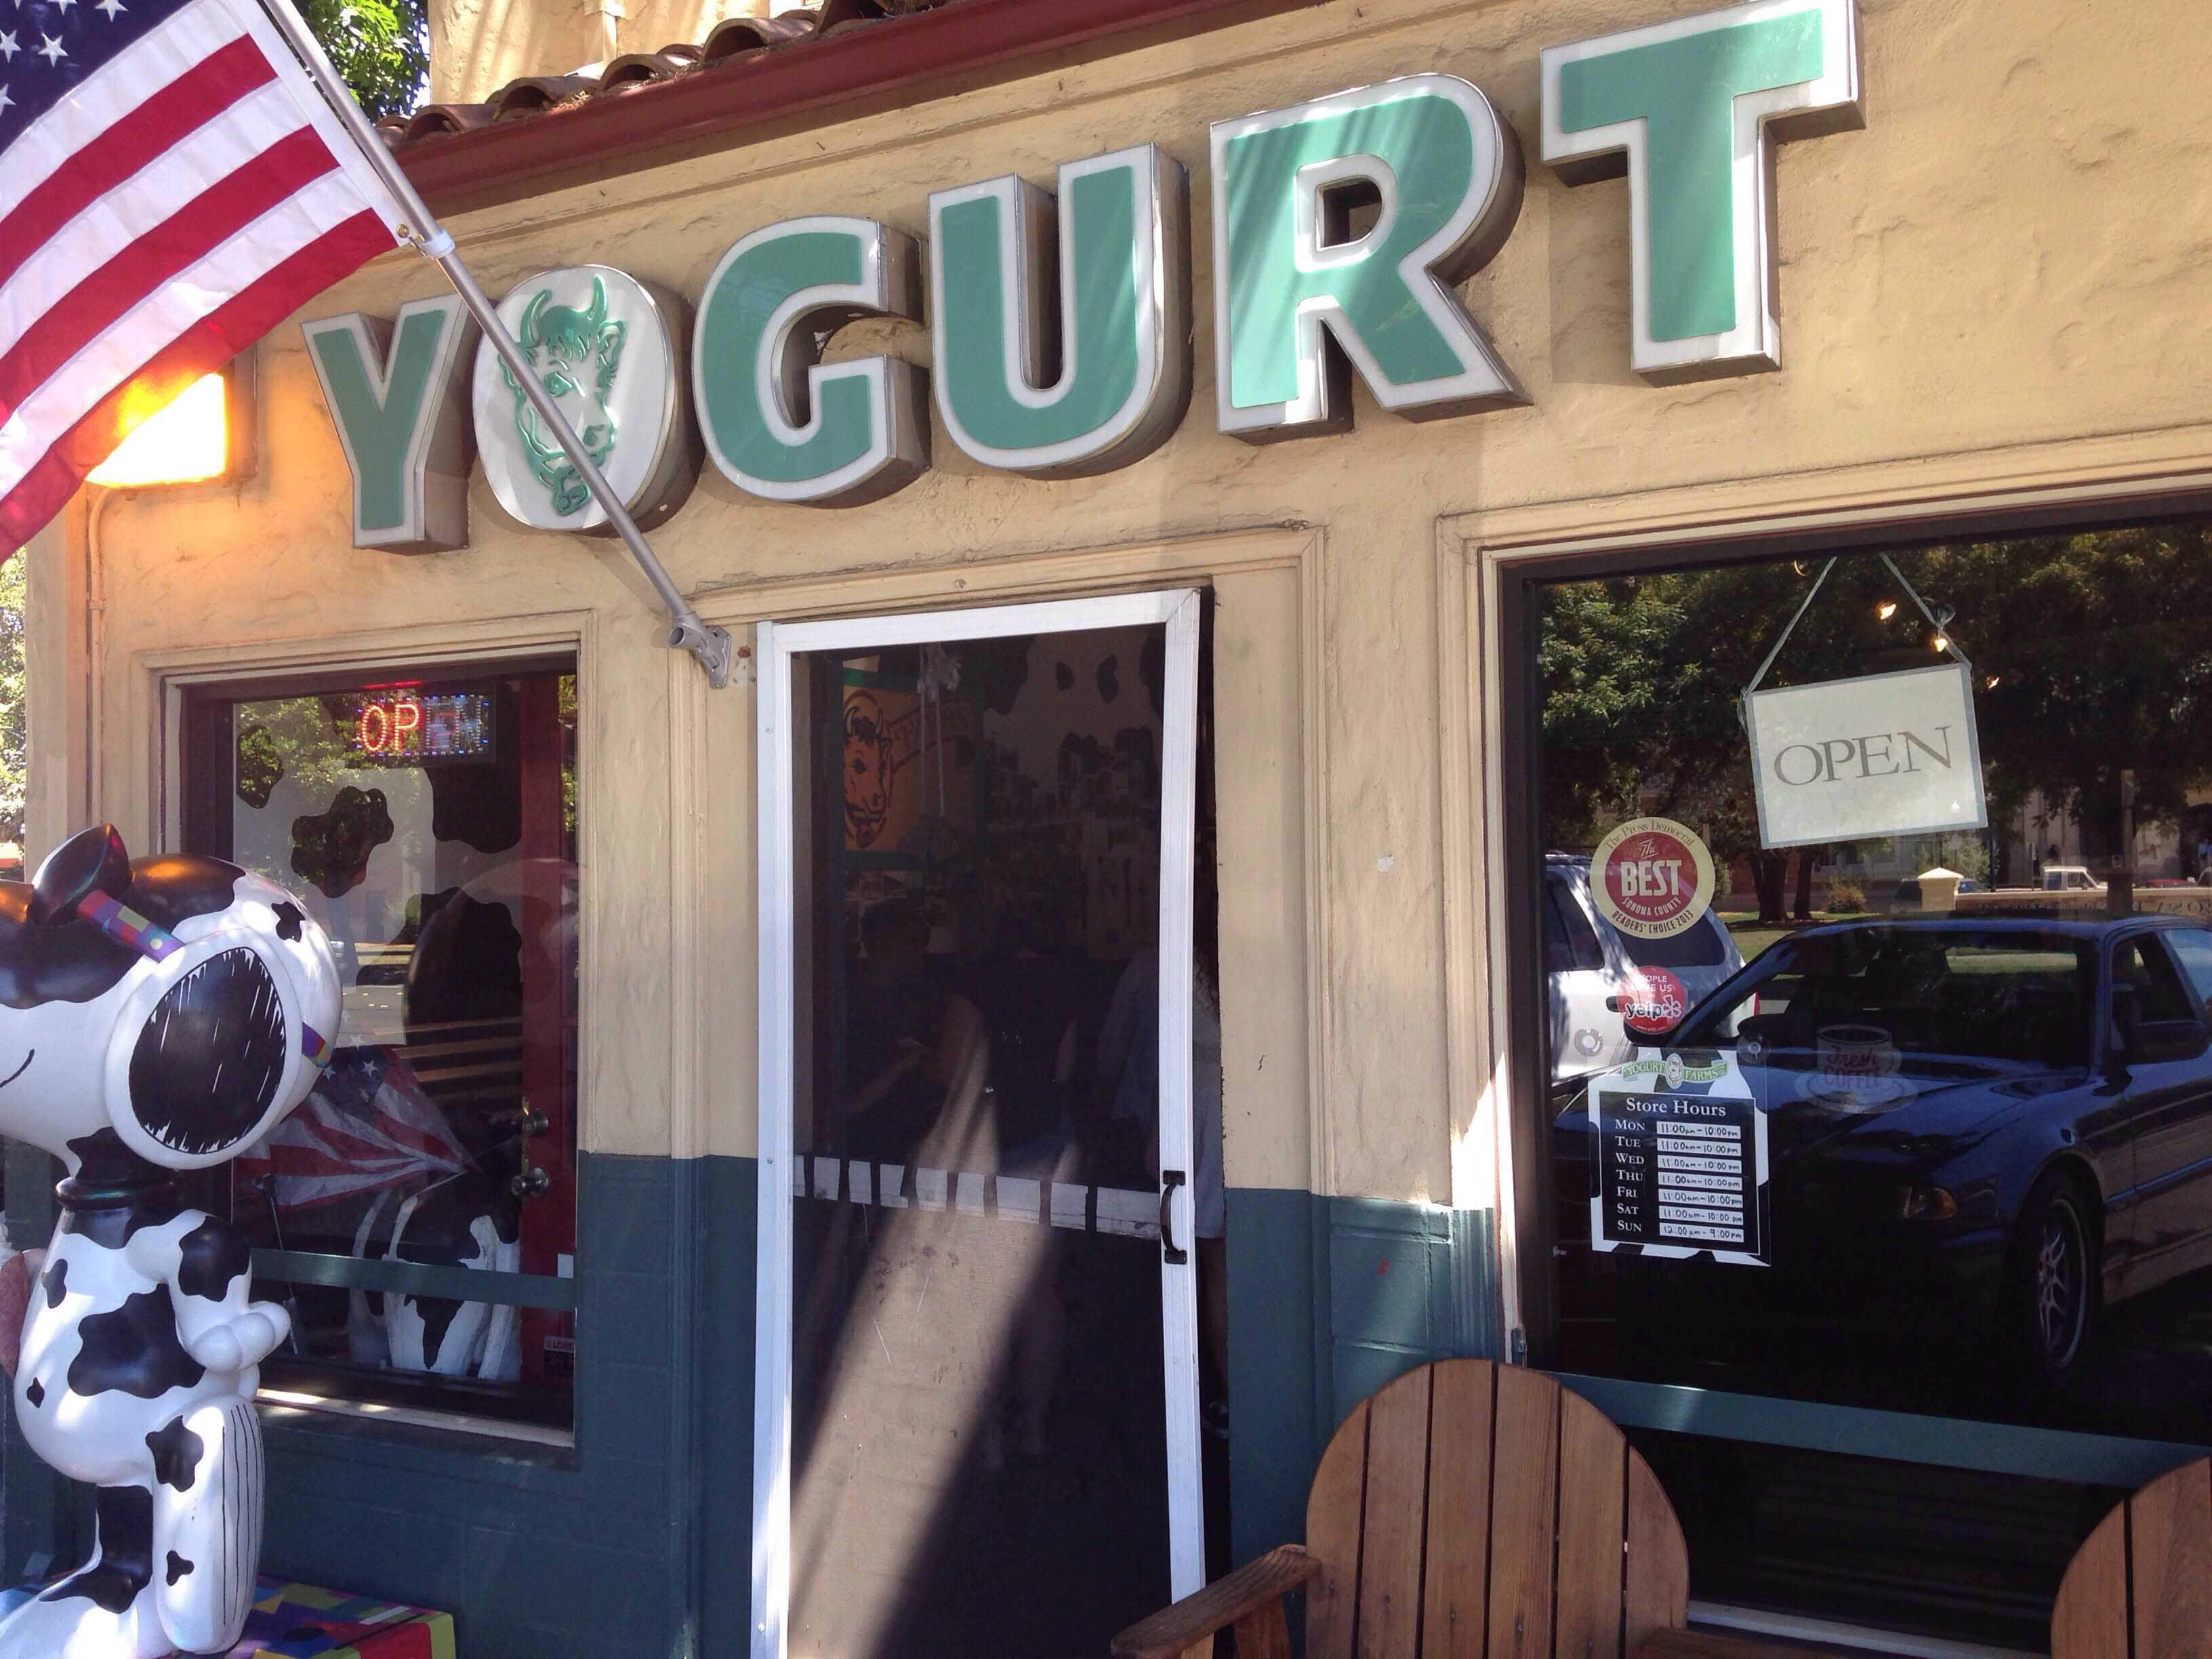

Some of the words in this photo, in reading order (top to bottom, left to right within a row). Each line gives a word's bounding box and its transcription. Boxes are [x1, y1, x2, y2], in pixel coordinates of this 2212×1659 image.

[302, 0, 1862, 548] YOGURT
[1774, 726, 1951, 786] OPEN
[1622, 823, 1649, 836] Press
[1650, 819, 1695, 846] Democrat
[1637, 838, 1660, 859] The
[1620, 859, 1682, 897] BEST
[1622, 897, 1652, 916] SONOMA
[1654, 897, 1683, 916] COUNTY
[1649, 920, 1676, 933] CHOICE
[1676, 909, 1694, 926] 2013
[1659, 984, 1673, 992] US
[1625, 1003, 1664, 1021] yelp
[1627, 1062, 1665, 1075] YOGURT
[1685, 1069, 1719, 1080] FARMS
[1626, 1097, 1668, 1113] Store
[1673, 1100, 1727, 1117] Hours
[1615, 1119, 1645, 1131] MON
[1615, 1135, 1641, 1147] TUE
[1616, 1153, 1645, 1165] WED
[1616, 1170, 1643, 1181] THU
[1617, 1186, 1638, 1198] FRI
[1617, 1203, 1639, 1215] SAT
[1618, 1219, 1642, 1232] SUN
